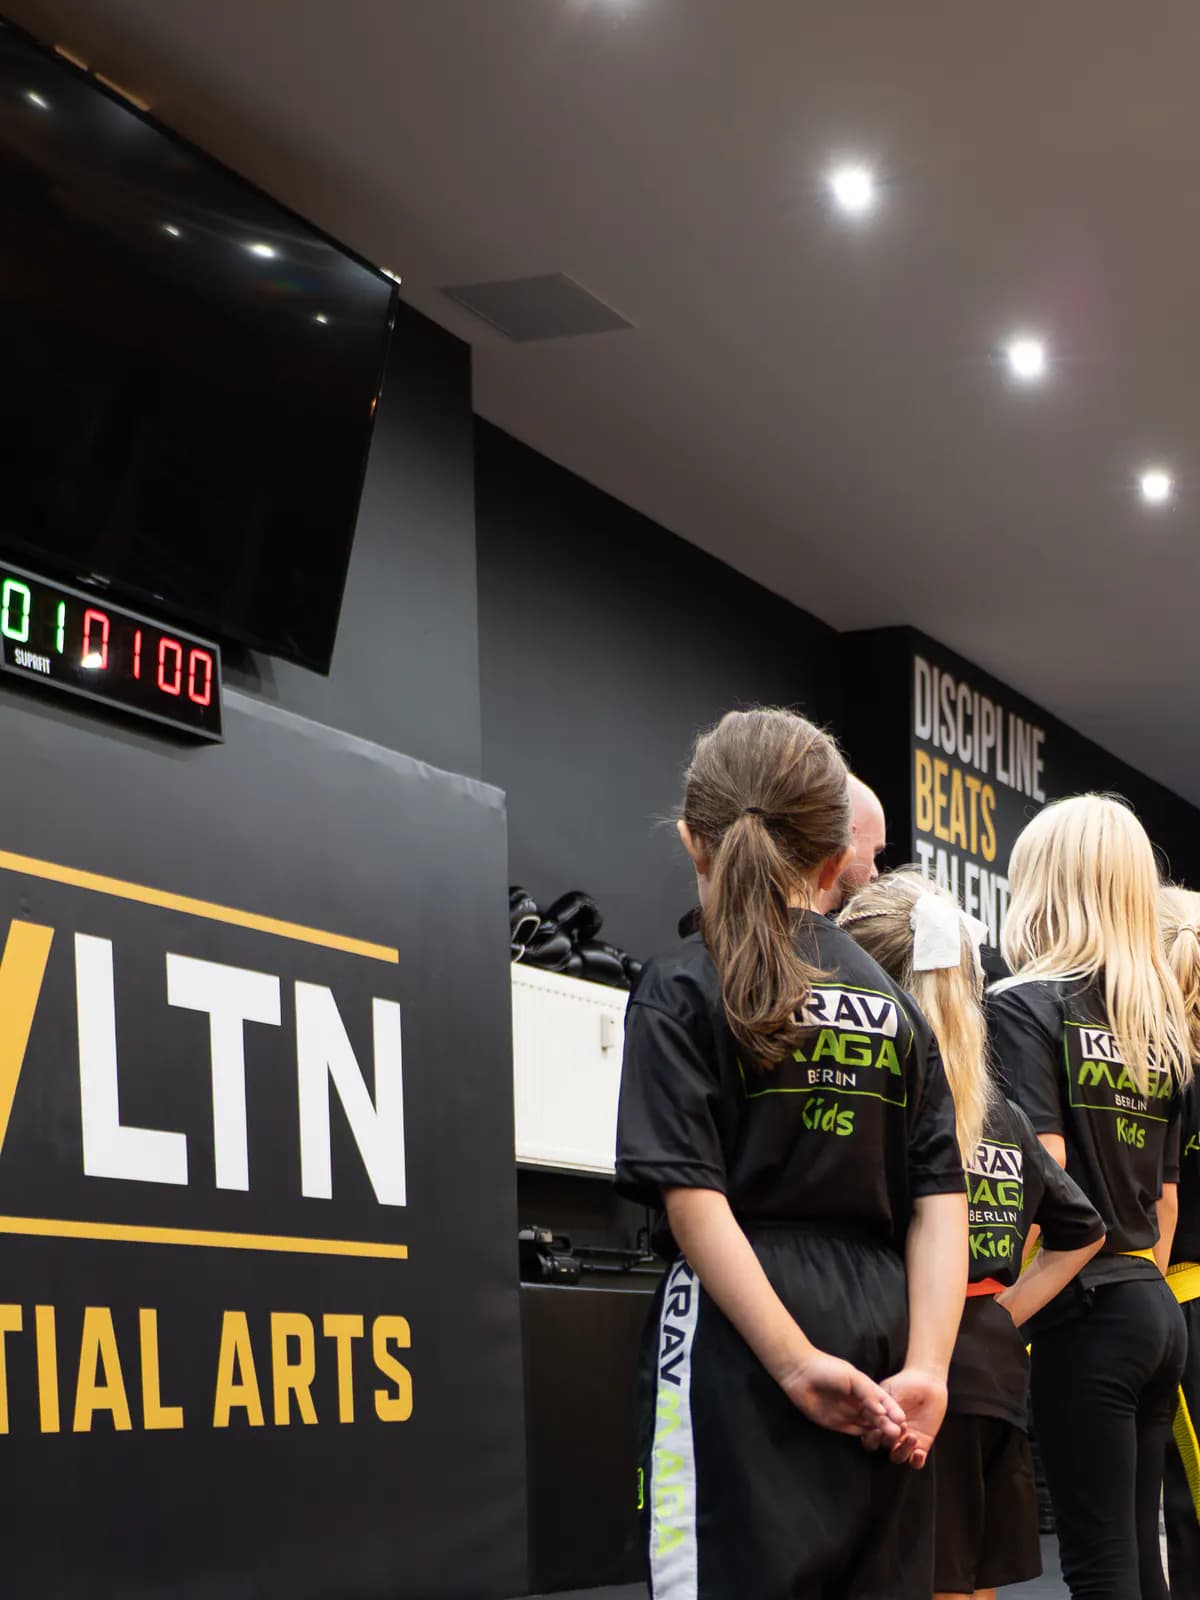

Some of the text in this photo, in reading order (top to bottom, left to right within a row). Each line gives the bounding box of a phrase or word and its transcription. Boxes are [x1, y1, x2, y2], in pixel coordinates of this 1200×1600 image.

[914, 655, 1046, 804] DISCIPLINE
[915, 748, 997, 862] BEATS
[793, 990, 892, 1030] RAV
[792, 1028, 903, 1076] AGA
[1114, 1094, 1148, 1112] BERLIN
[969, 1210, 1018, 1223] BERLIN
[969, 1231, 1015, 1260] Kid
[213, 1310, 413, 1428] ARTS
[655, 1388, 685, 1558] MAGA
